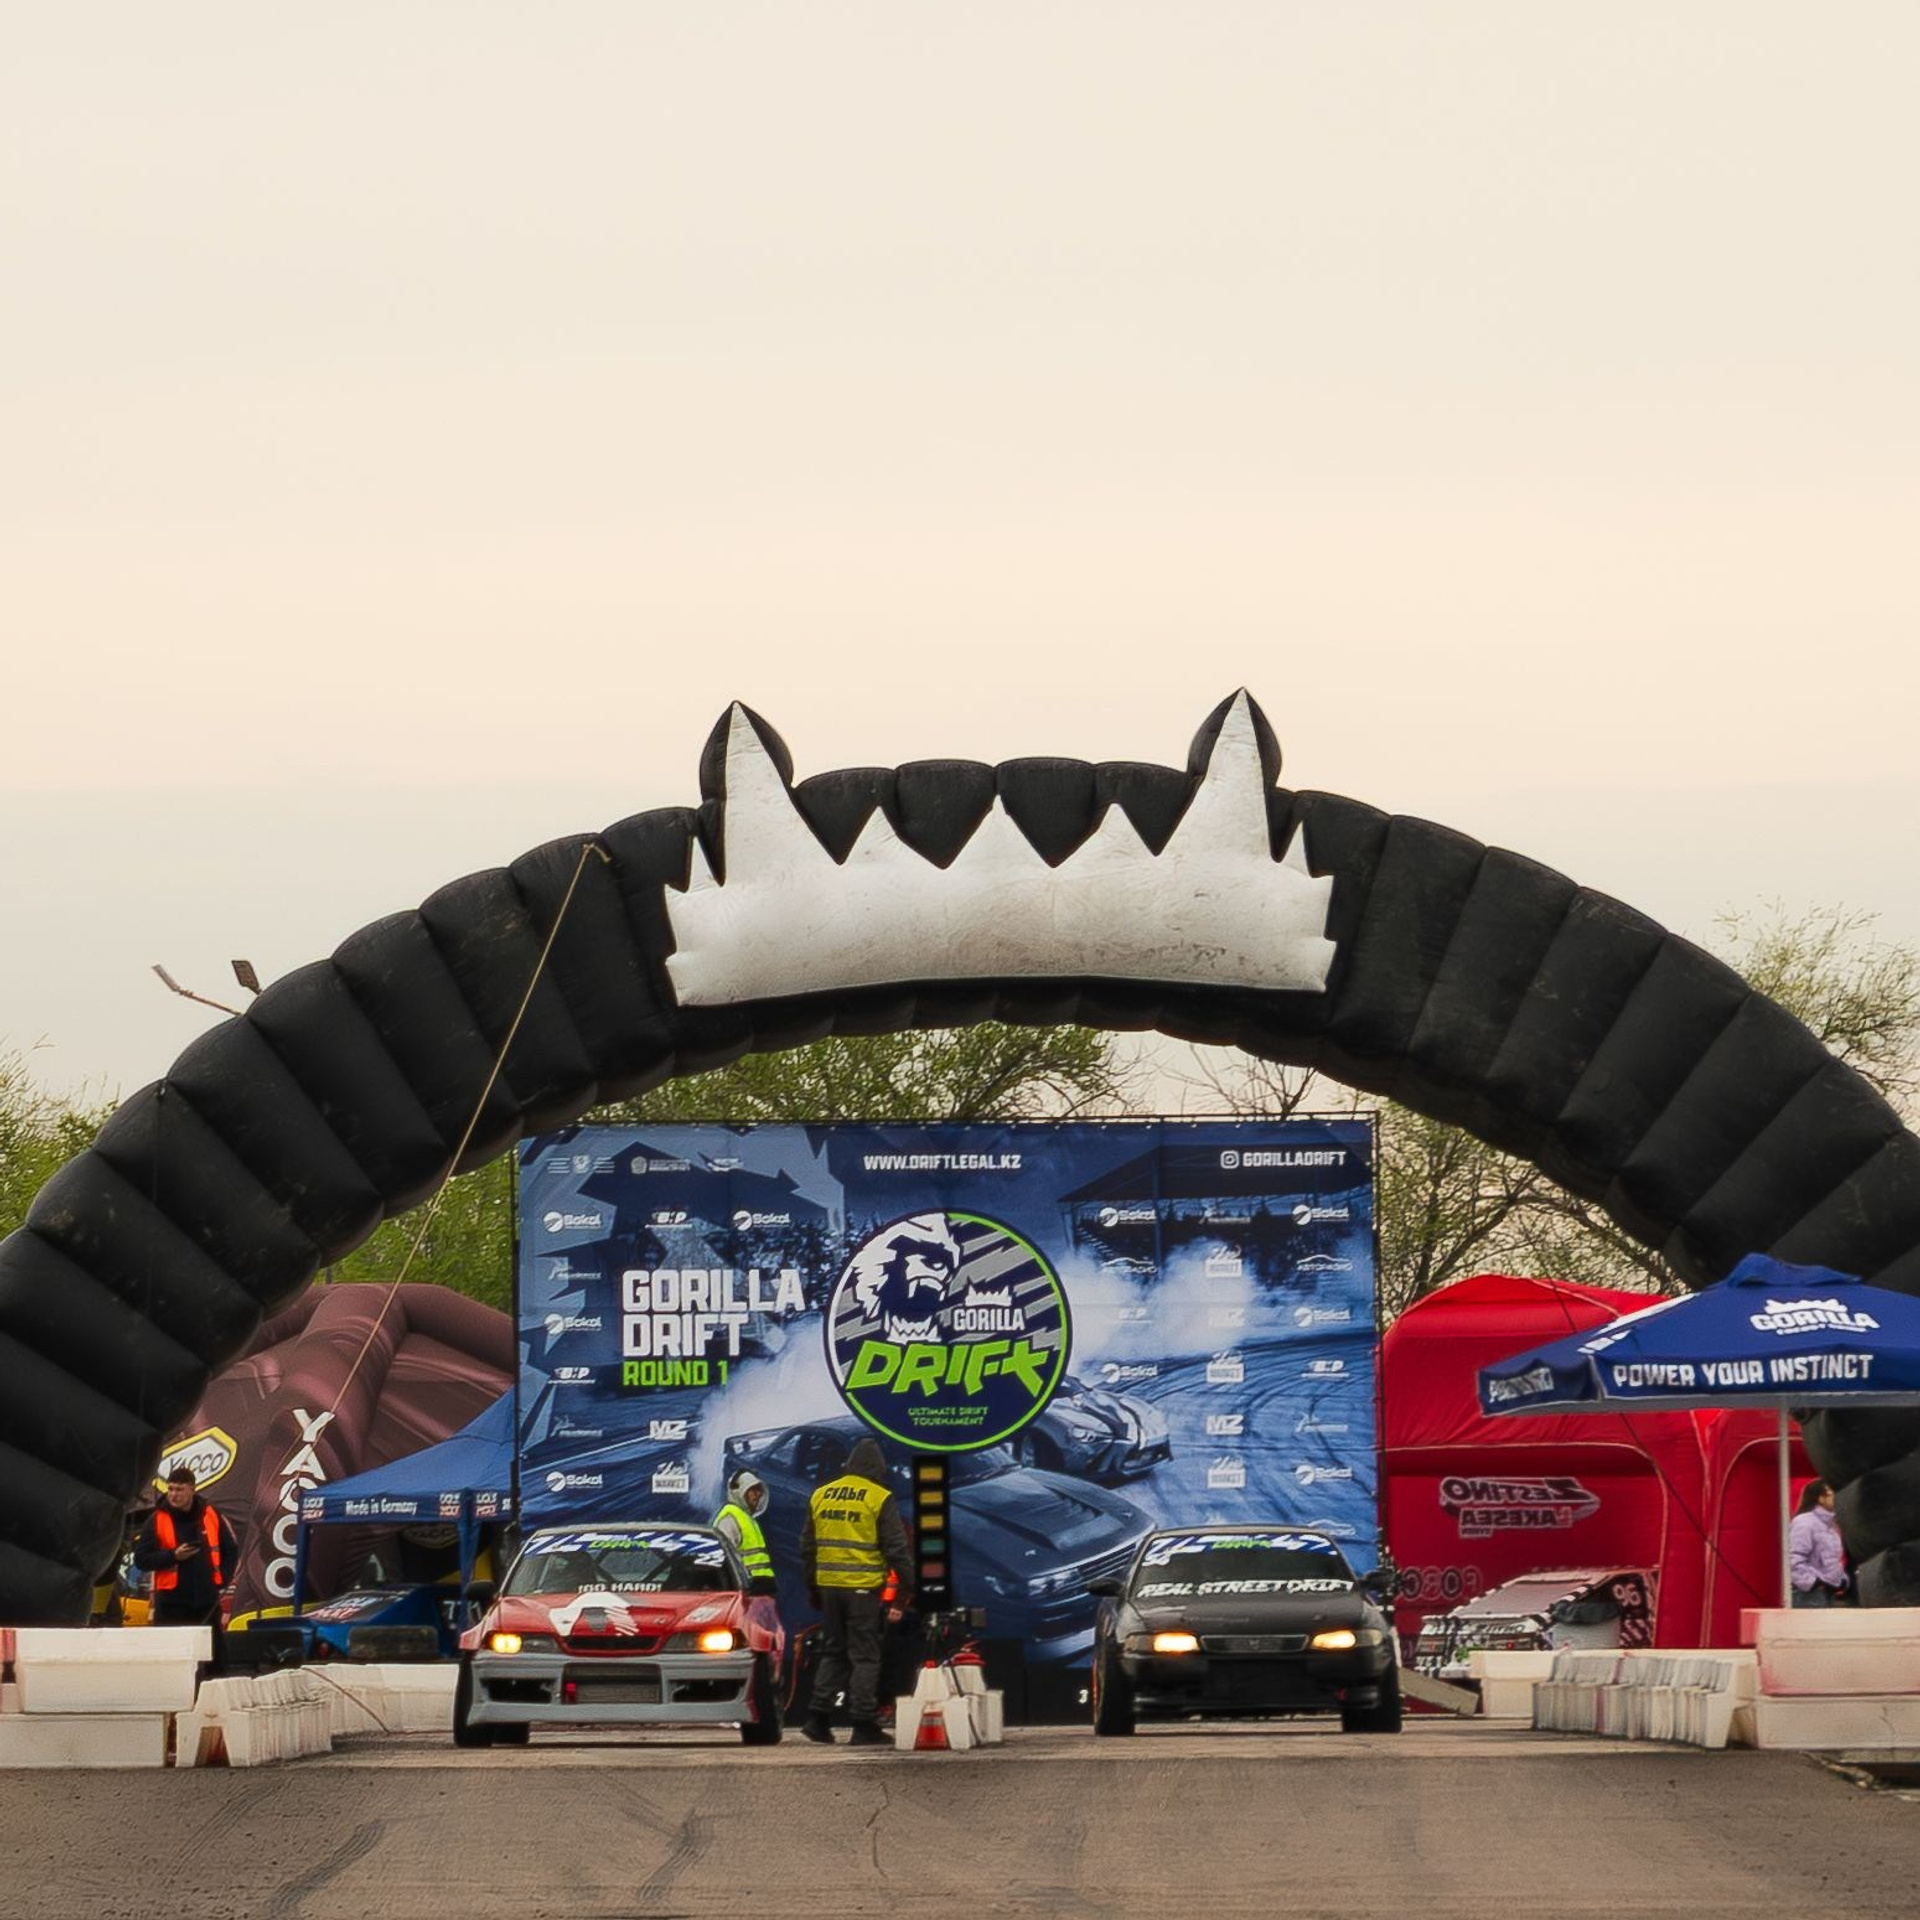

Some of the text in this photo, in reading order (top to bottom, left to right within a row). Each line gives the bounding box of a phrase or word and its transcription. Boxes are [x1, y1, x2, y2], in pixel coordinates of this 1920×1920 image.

[864, 1154, 1021, 1170] WWW.DRIFTLEGAL.KZ
[1243, 1151, 1347, 1167] GORILLADRIFT
[622, 1270, 806, 1312] GORILLA
[953, 1308, 1025, 1331] GORILLA
[1750, 1310, 1880, 1331] GORILLA
[623, 1313, 749, 1357] DRIFT
[623, 1361, 709, 1386] ROUND
[718, 1360, 729, 1386] 1
[1613, 1354, 1874, 1387] POWER YOUR INSTINCT
[823, 1486, 867, 1501] СУДЬЯ
[345, 1498, 418, 1515] Made in Germany
[1137, 1579, 1354, 1598] REAL STREET DRIFT
[834, 1691, 845, 1706] 2
[1078, 1689, 1089, 1704] 3
